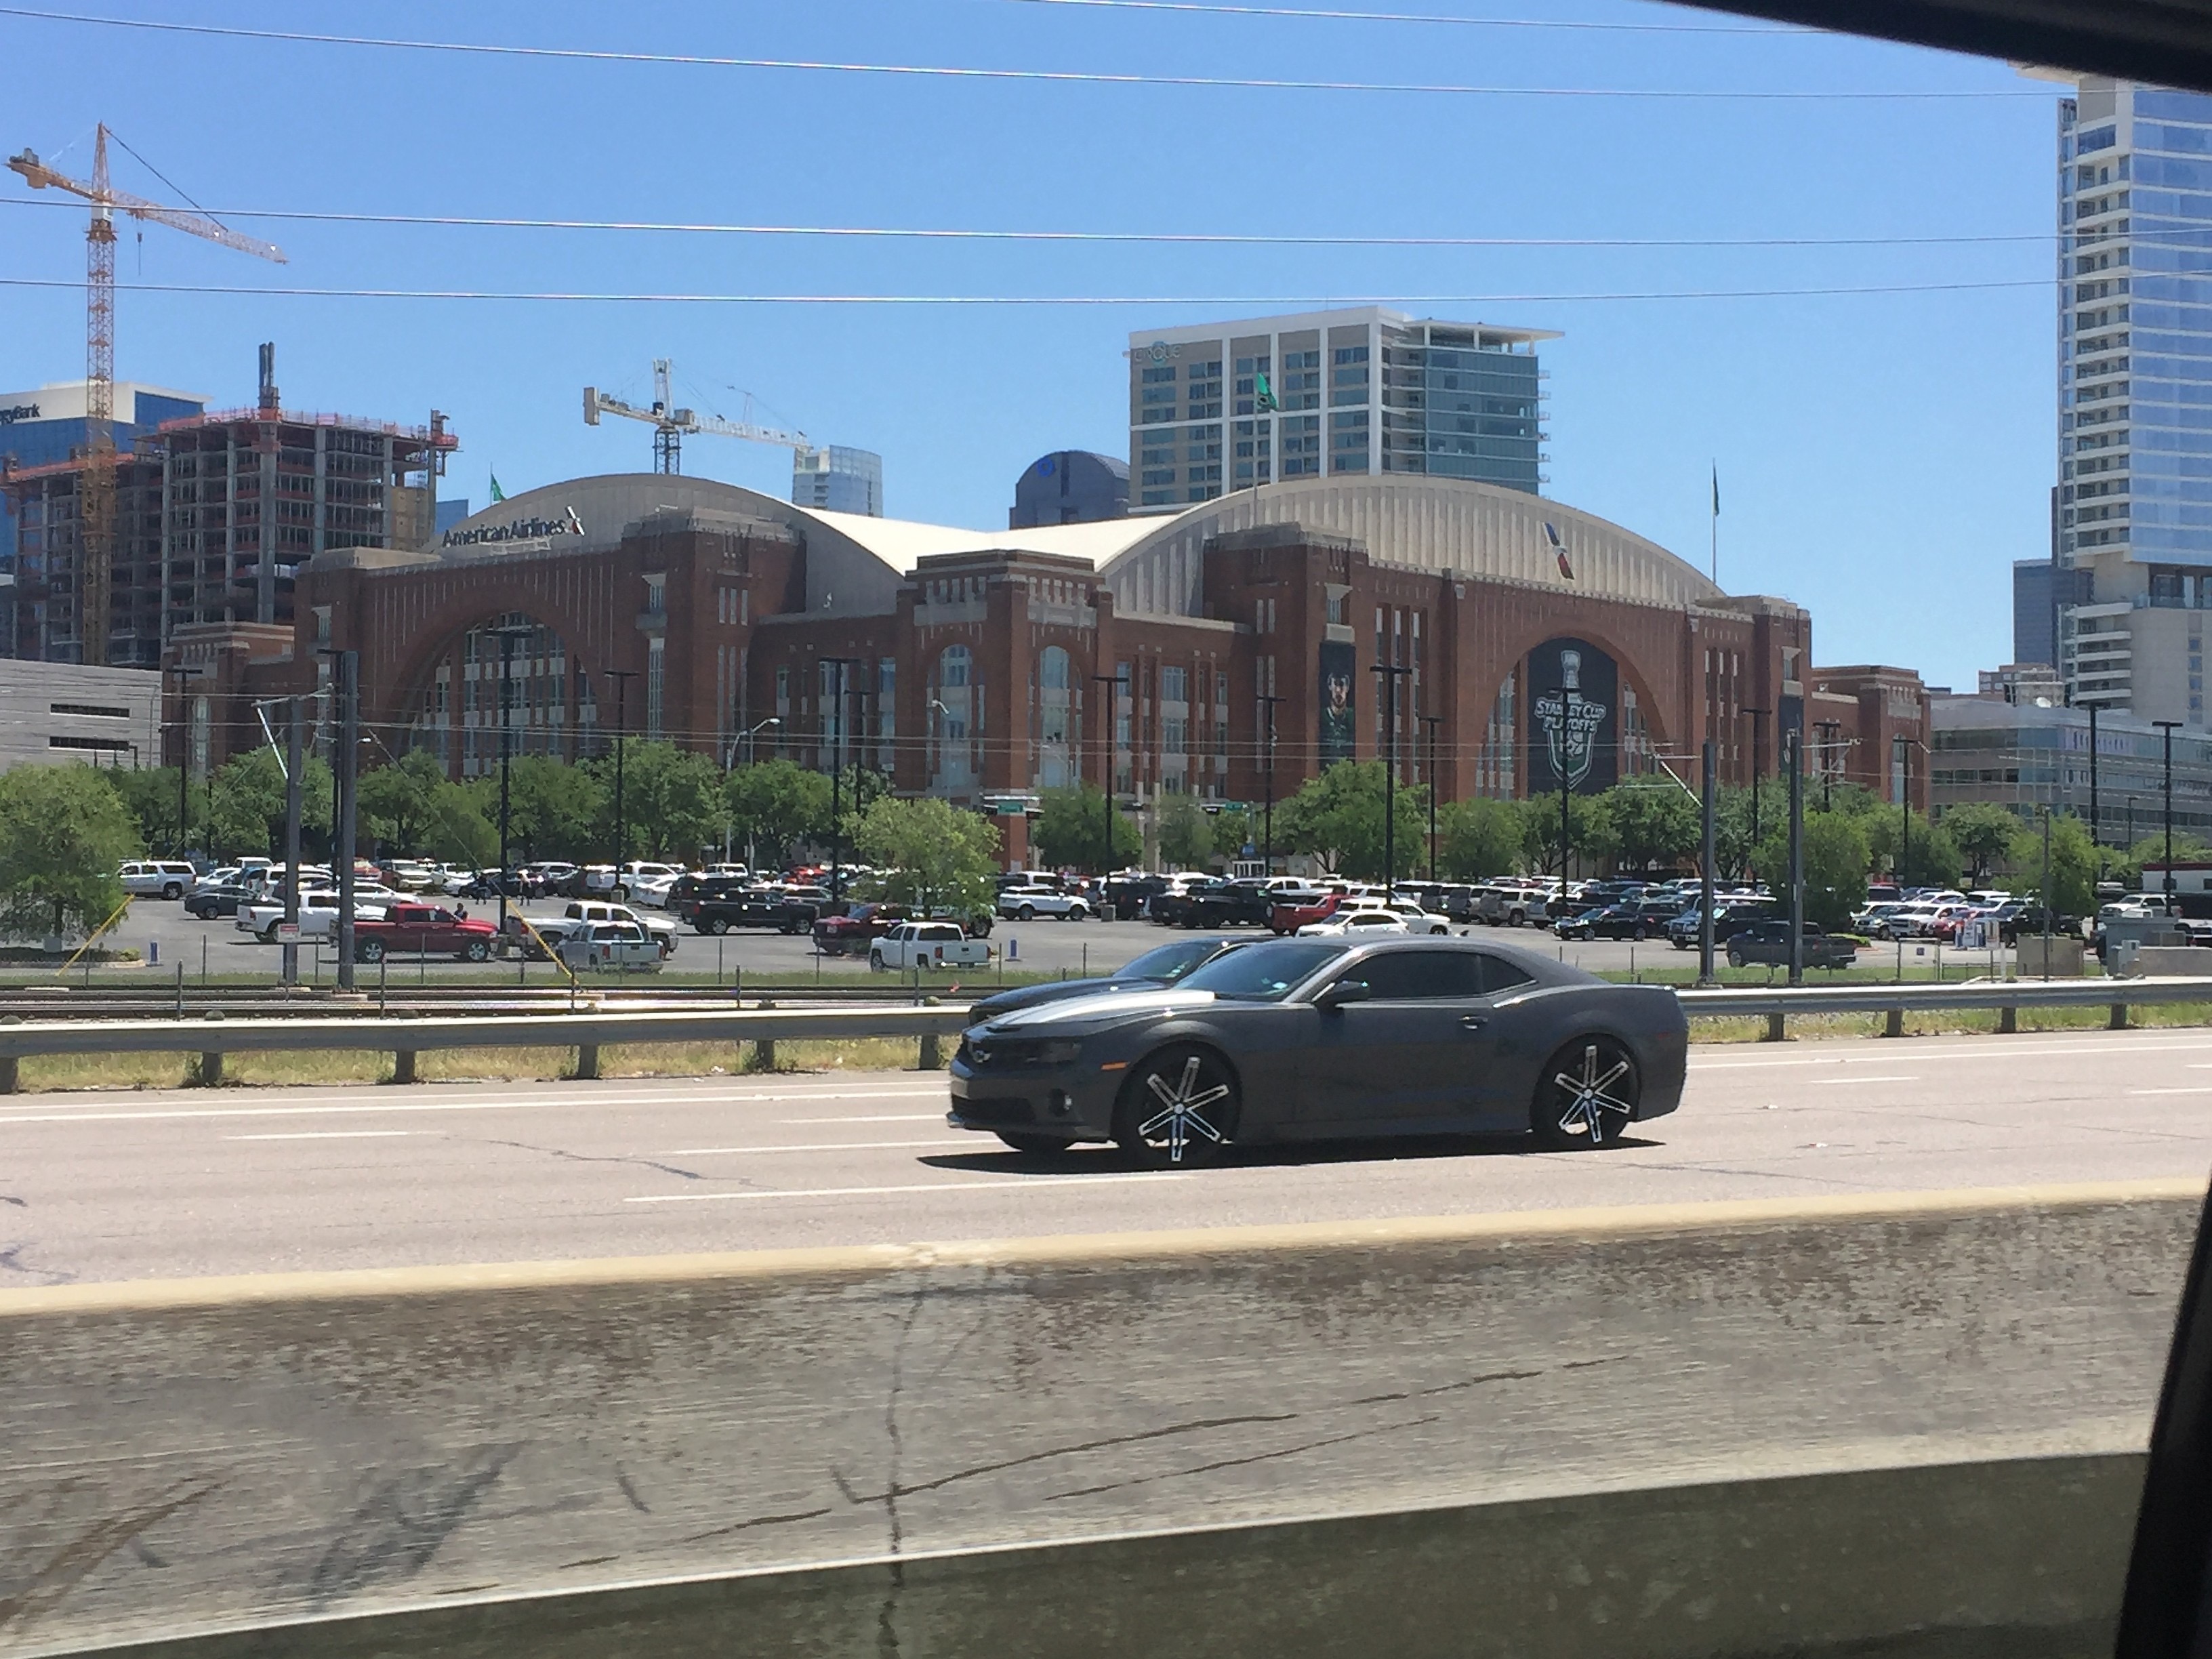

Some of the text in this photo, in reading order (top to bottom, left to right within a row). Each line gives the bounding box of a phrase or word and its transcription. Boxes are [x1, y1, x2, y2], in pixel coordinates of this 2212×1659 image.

[443, 516, 567, 548] American Airlines
[1536, 700, 1605, 719] STANEY CUP
